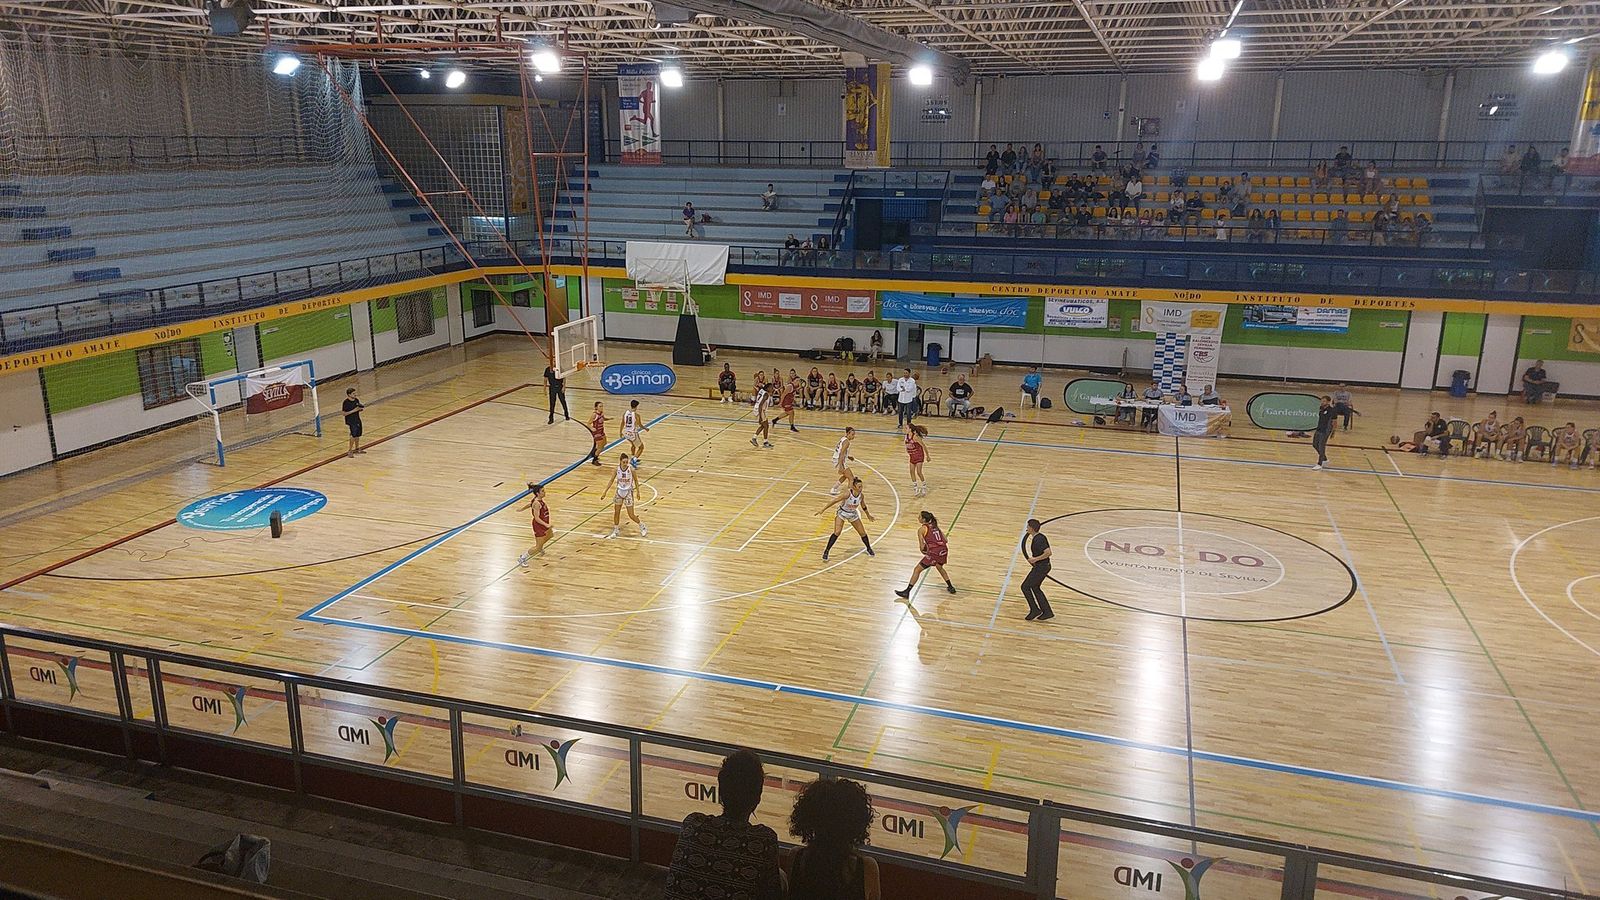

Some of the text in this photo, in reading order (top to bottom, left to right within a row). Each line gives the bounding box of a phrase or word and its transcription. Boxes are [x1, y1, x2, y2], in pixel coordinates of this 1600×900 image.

[825, 295, 840, 303] IMD
[1037, 288, 1097, 296] DEPORTIVO
[1105, 290, 1138, 298] AMATE
[1236, 294, 1301, 303] INSTITUTO
[1354, 299, 1416, 308] DEPORTES
[1163, 308, 1182, 317] IMD
[82, 340, 121, 355] AMATE
[213, 312, 266, 328] INSTITUTO
[278, 307, 289, 315] DE
[302, 297, 342, 310] DEPORTES
[263, 384, 289, 401] SEVILLA
[1175, 412, 1197, 422] IMD
